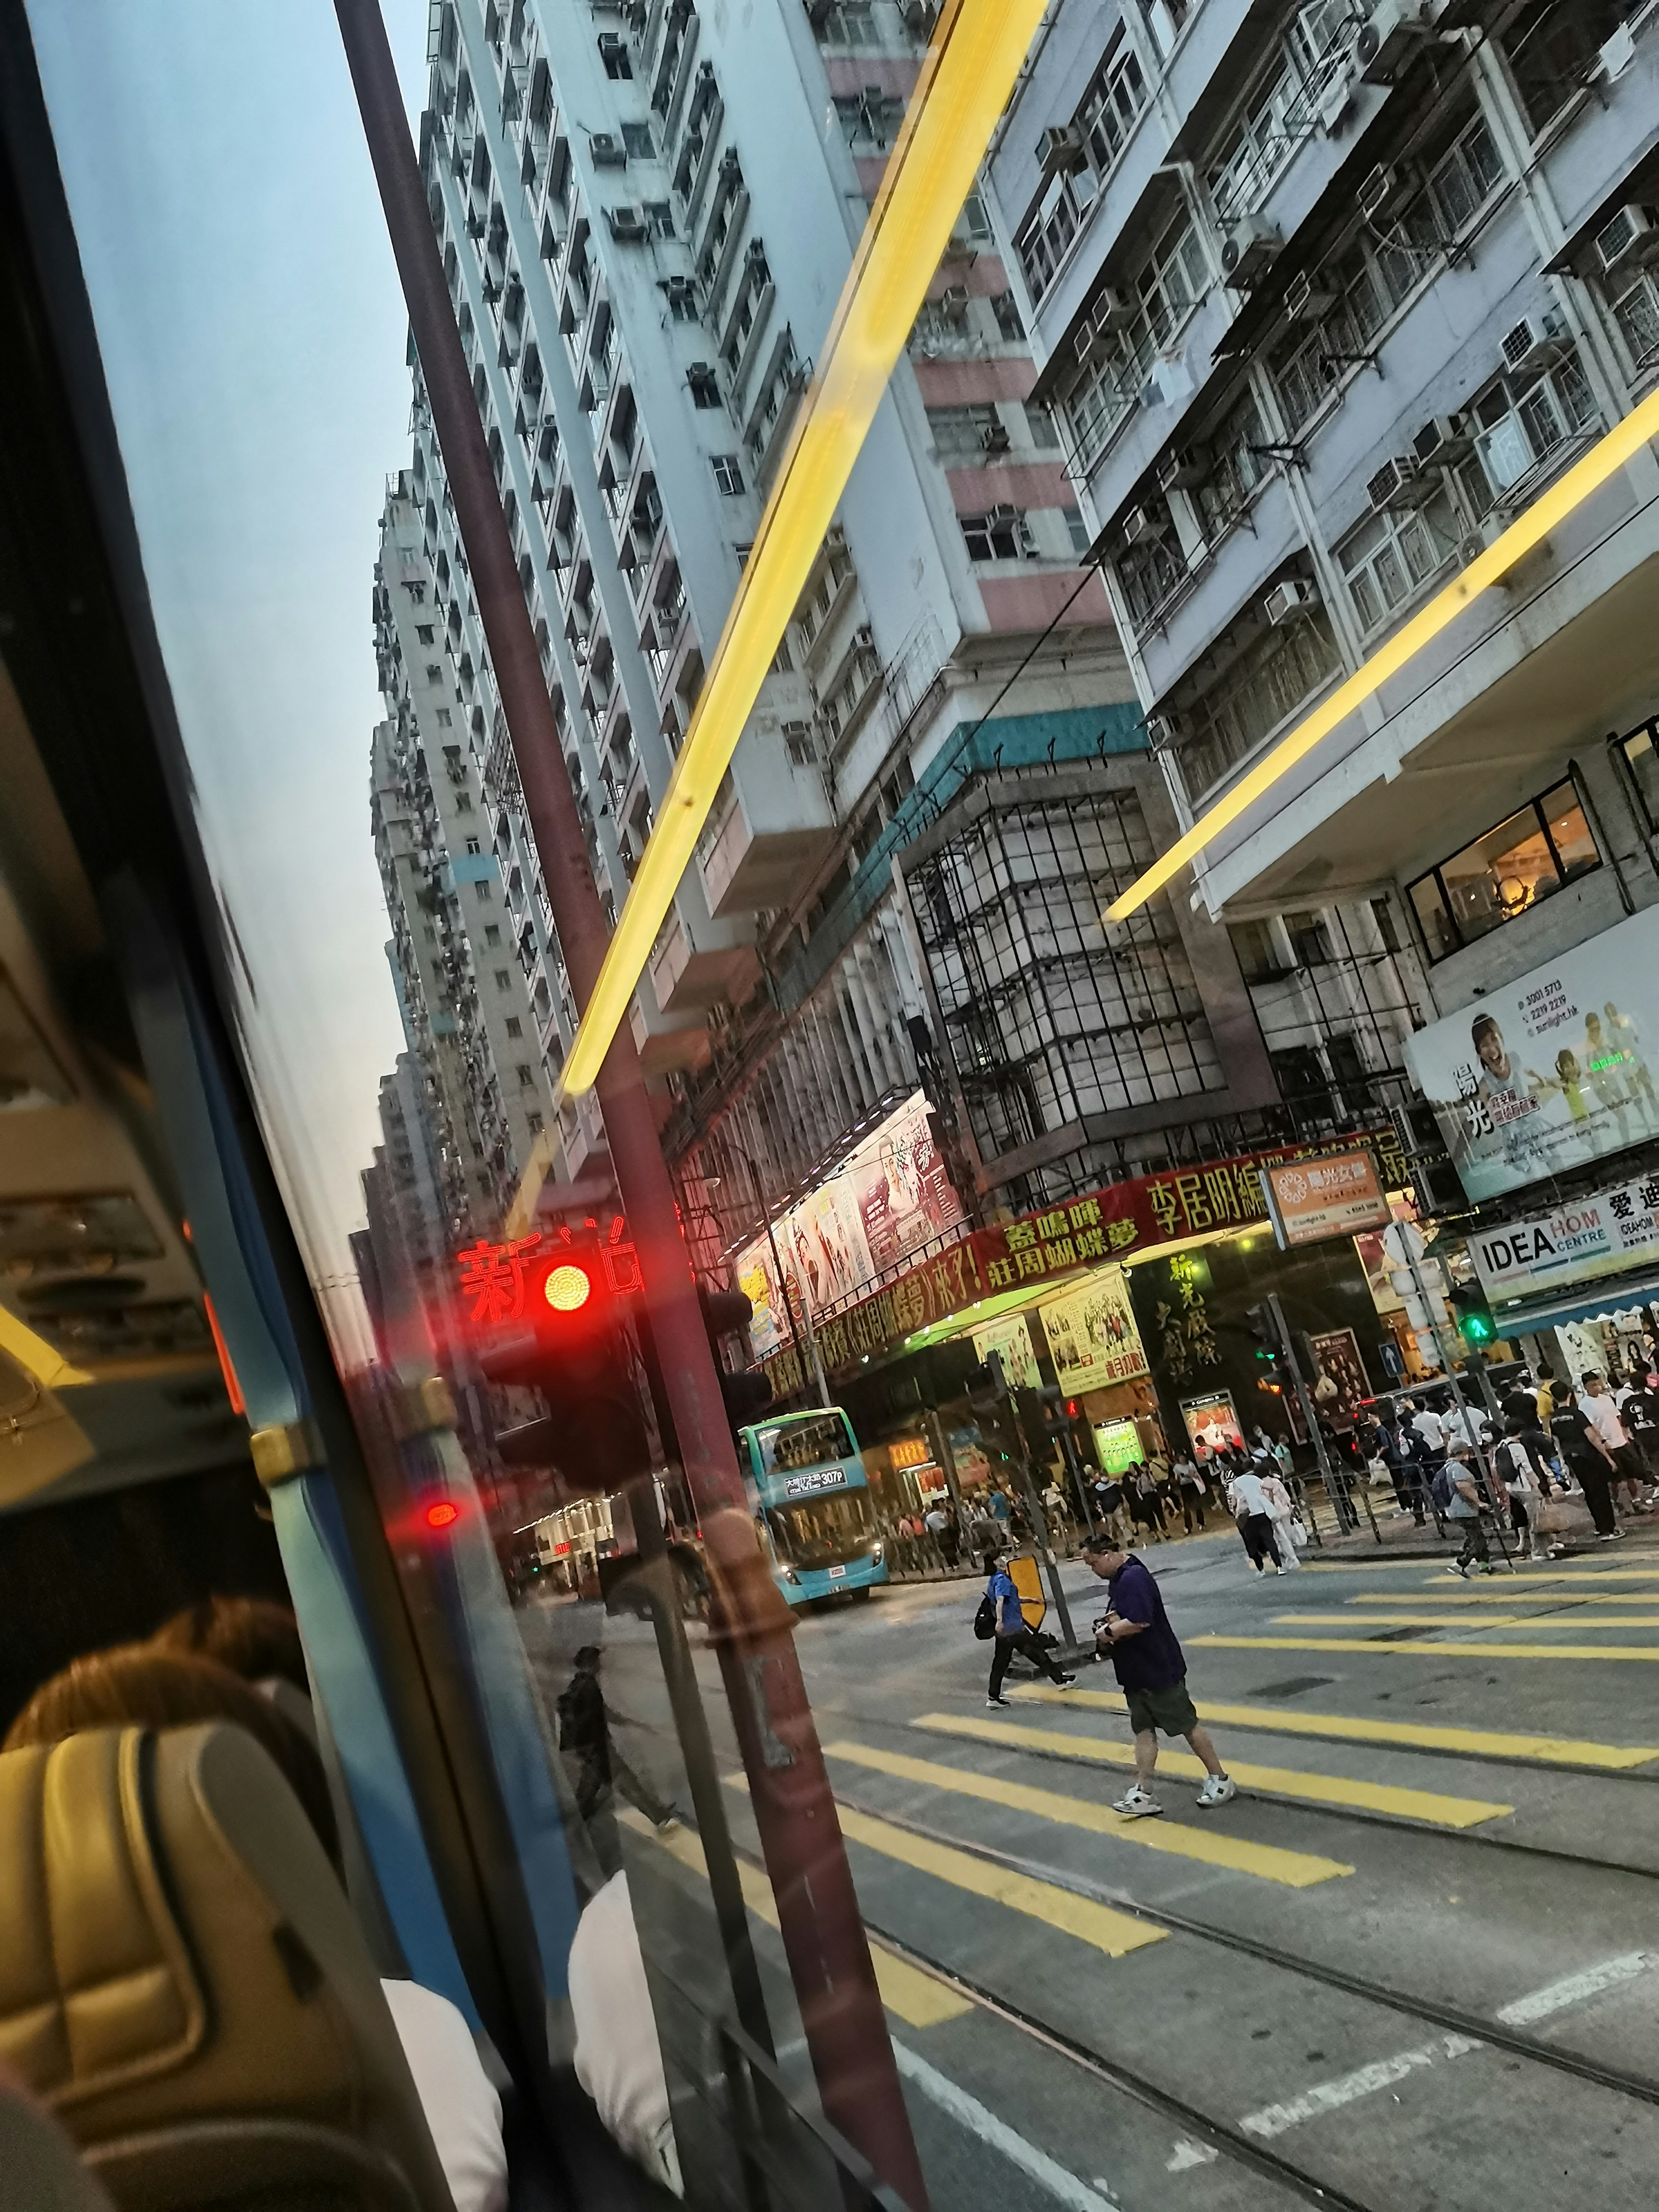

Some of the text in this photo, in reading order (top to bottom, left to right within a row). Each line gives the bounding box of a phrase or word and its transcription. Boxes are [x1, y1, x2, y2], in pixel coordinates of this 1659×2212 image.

[1526, 979, 1562, 1006] 3001 5713
[1530, 994, 1566, 1021] 2219 2219
[986, 1217, 1139, 1289] 莊周蝴蝶夢
[1482, 1227, 1556, 1272] IDEA
[1557, 1229, 1606, 1251] CENTRE
[821, 1471, 842, 1485] 307P
